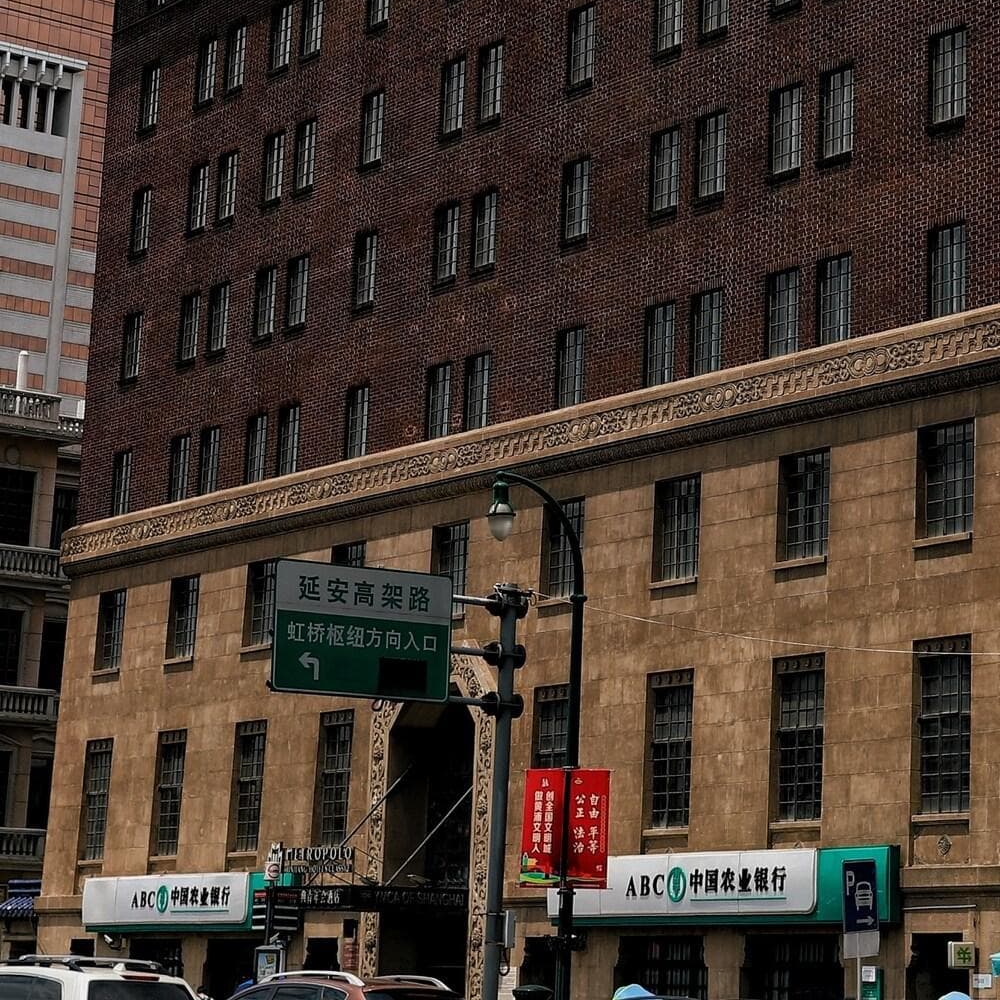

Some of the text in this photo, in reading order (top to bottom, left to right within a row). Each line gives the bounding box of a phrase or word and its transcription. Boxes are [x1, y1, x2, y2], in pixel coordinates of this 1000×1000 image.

[299, 576, 430, 612] 延安高架路
[287, 621, 437, 651] 虹桥枢纽方向入口
[589, 794, 600, 819] 自由
[573, 794, 586, 854] 公正 法治
[587, 826, 599, 854] 平等
[625, 874, 665, 897] ABC
[690, 865, 787, 894] 中国农业银行
[846, 870, 855, 896] P
[131, 891, 156, 908] ABC
[170, 886, 231, 907] 中国农业银行
